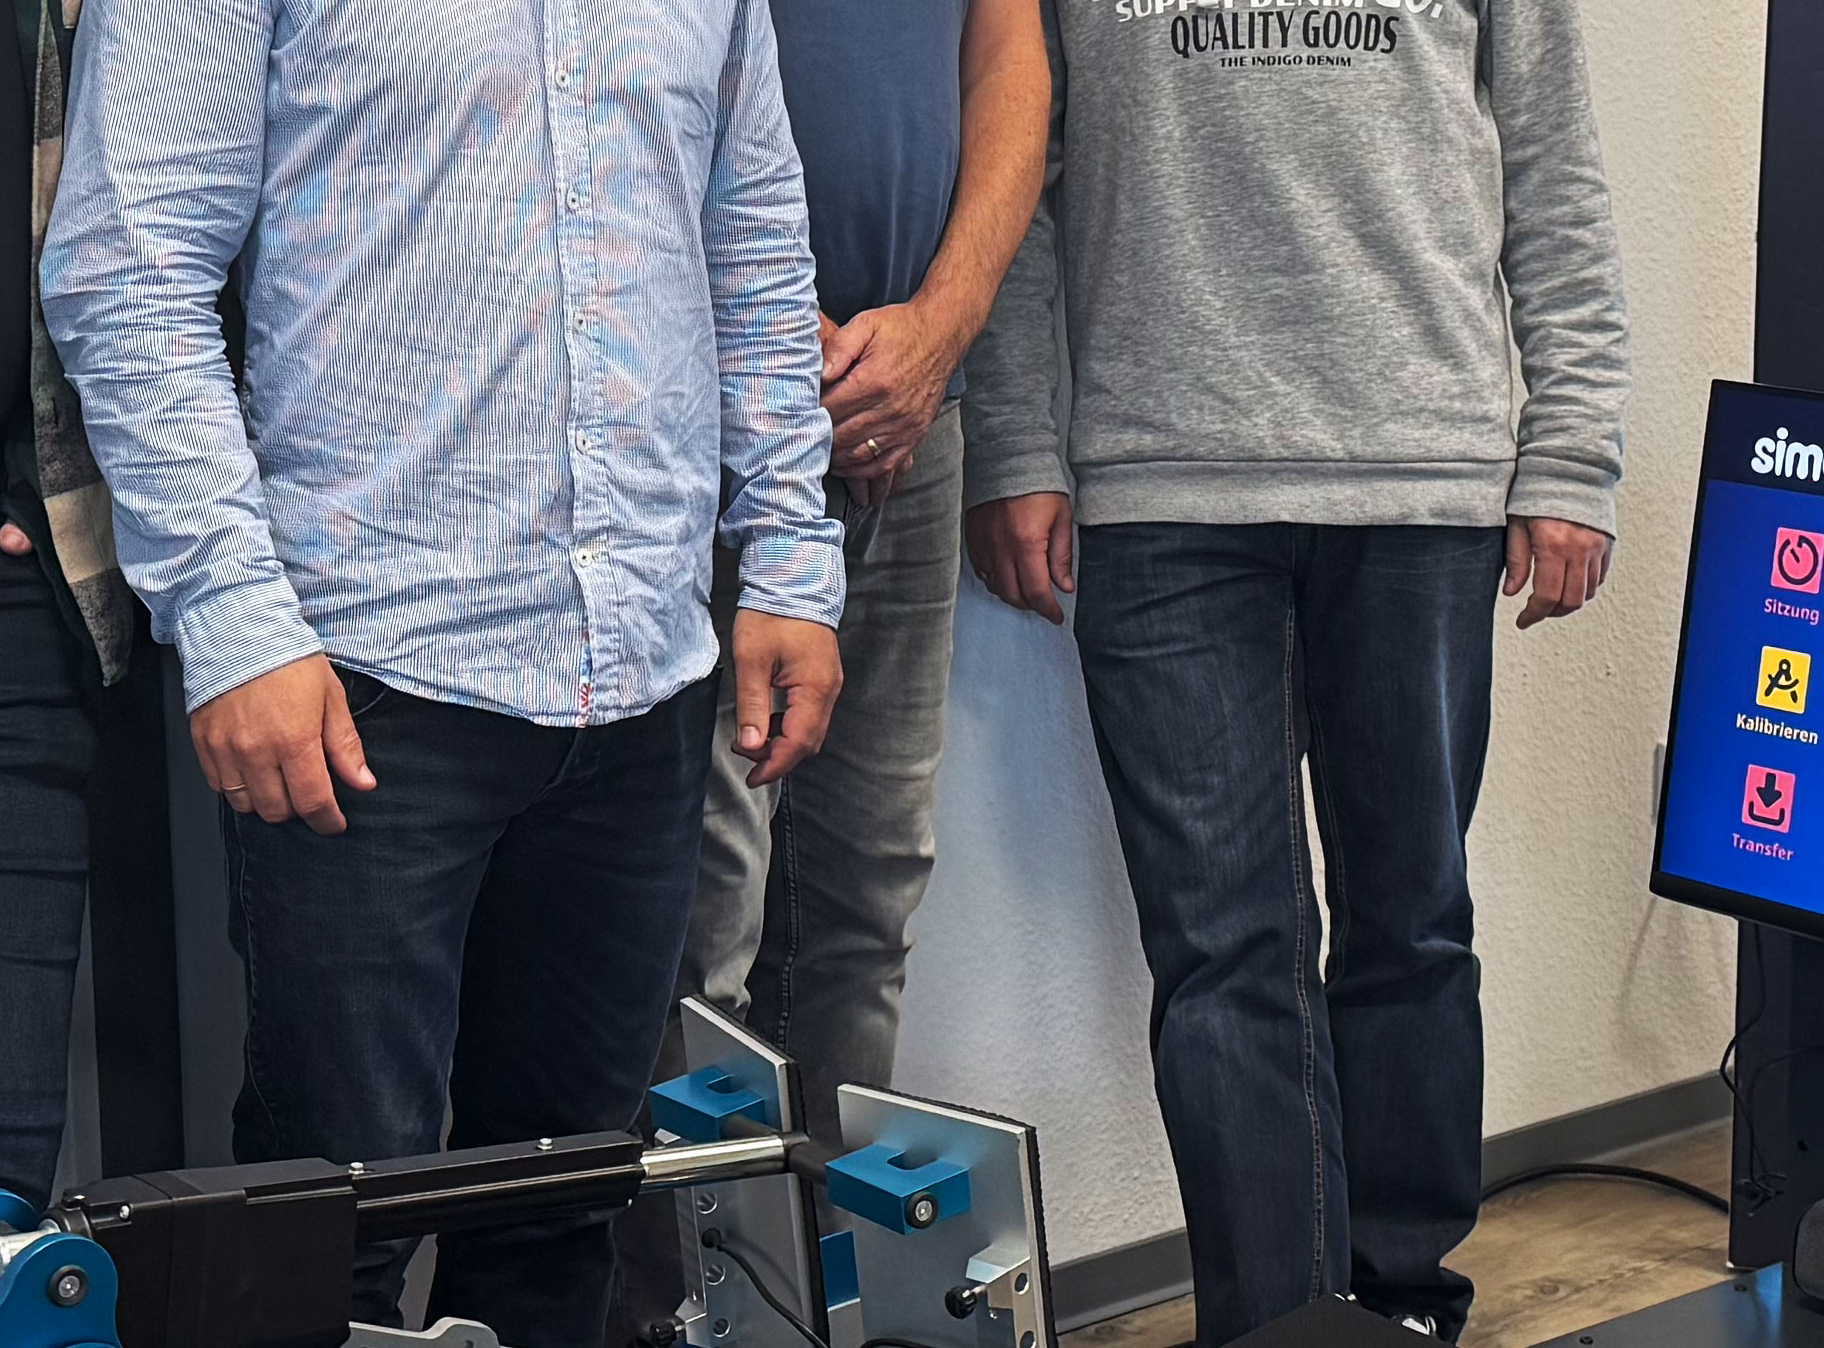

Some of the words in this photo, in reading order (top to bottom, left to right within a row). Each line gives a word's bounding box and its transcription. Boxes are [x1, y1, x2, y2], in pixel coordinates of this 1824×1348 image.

[1170, 9, 1295, 60] QUALITY
[1302, 9, 1401, 55] GOODS
[1219, 56, 1248, 68] THE
[1251, 55, 1304, 68] INDIGO
[1306, 56, 1353, 67] DENIM
[1764, 598, 1820, 626] Sitzung
[1736, 713, 1819, 745] Kalibrieren
[1732, 833, 1794, 861] Transfer
